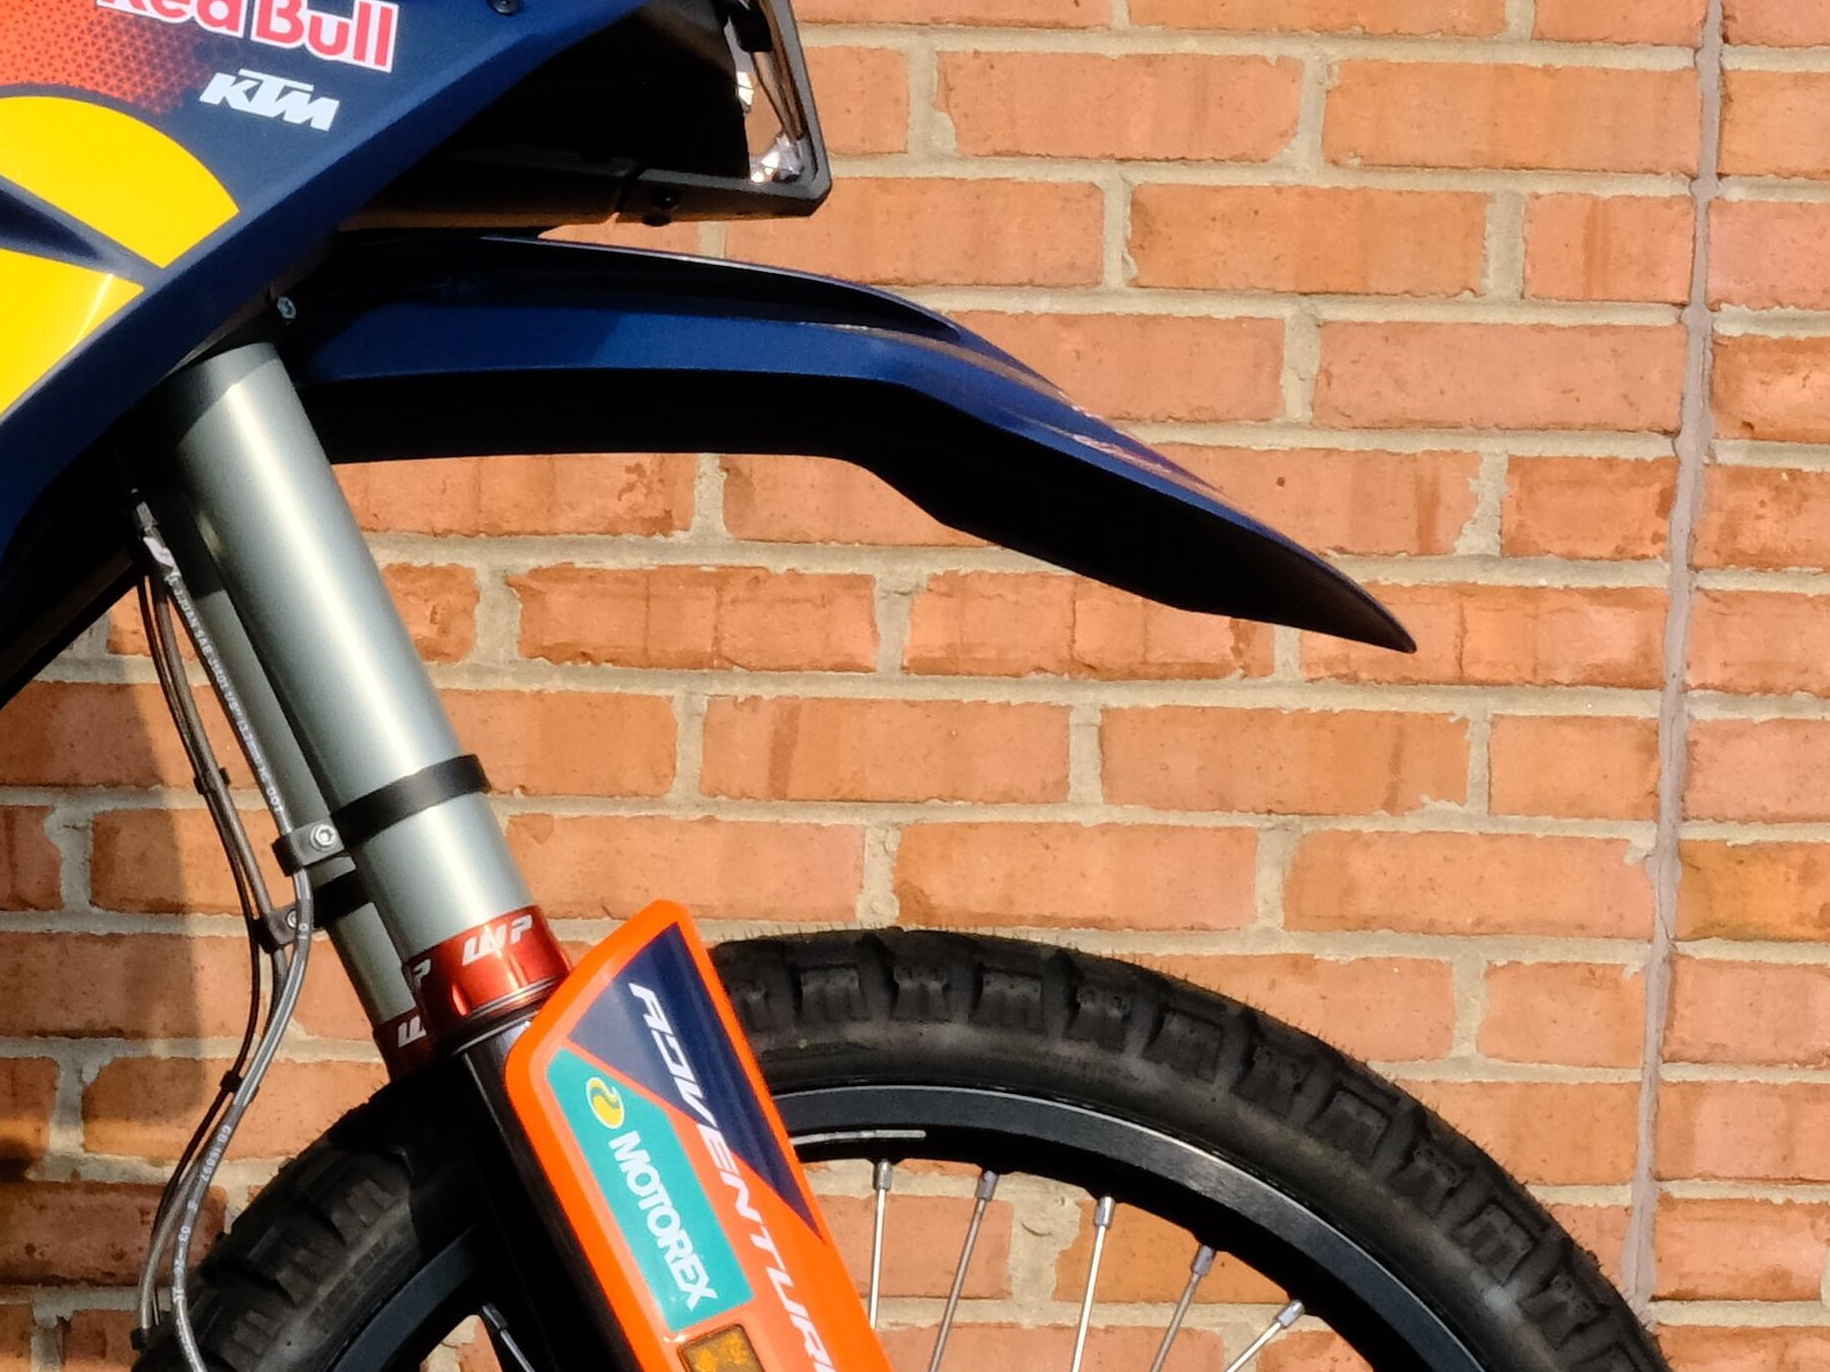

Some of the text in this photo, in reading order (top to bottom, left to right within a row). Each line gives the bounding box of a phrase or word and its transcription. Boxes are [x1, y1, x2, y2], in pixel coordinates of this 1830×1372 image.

[200, 69, 340, 131] KTM
[462, 914, 532, 965] WP
[608, 1132, 719, 1311] MOTOREX
